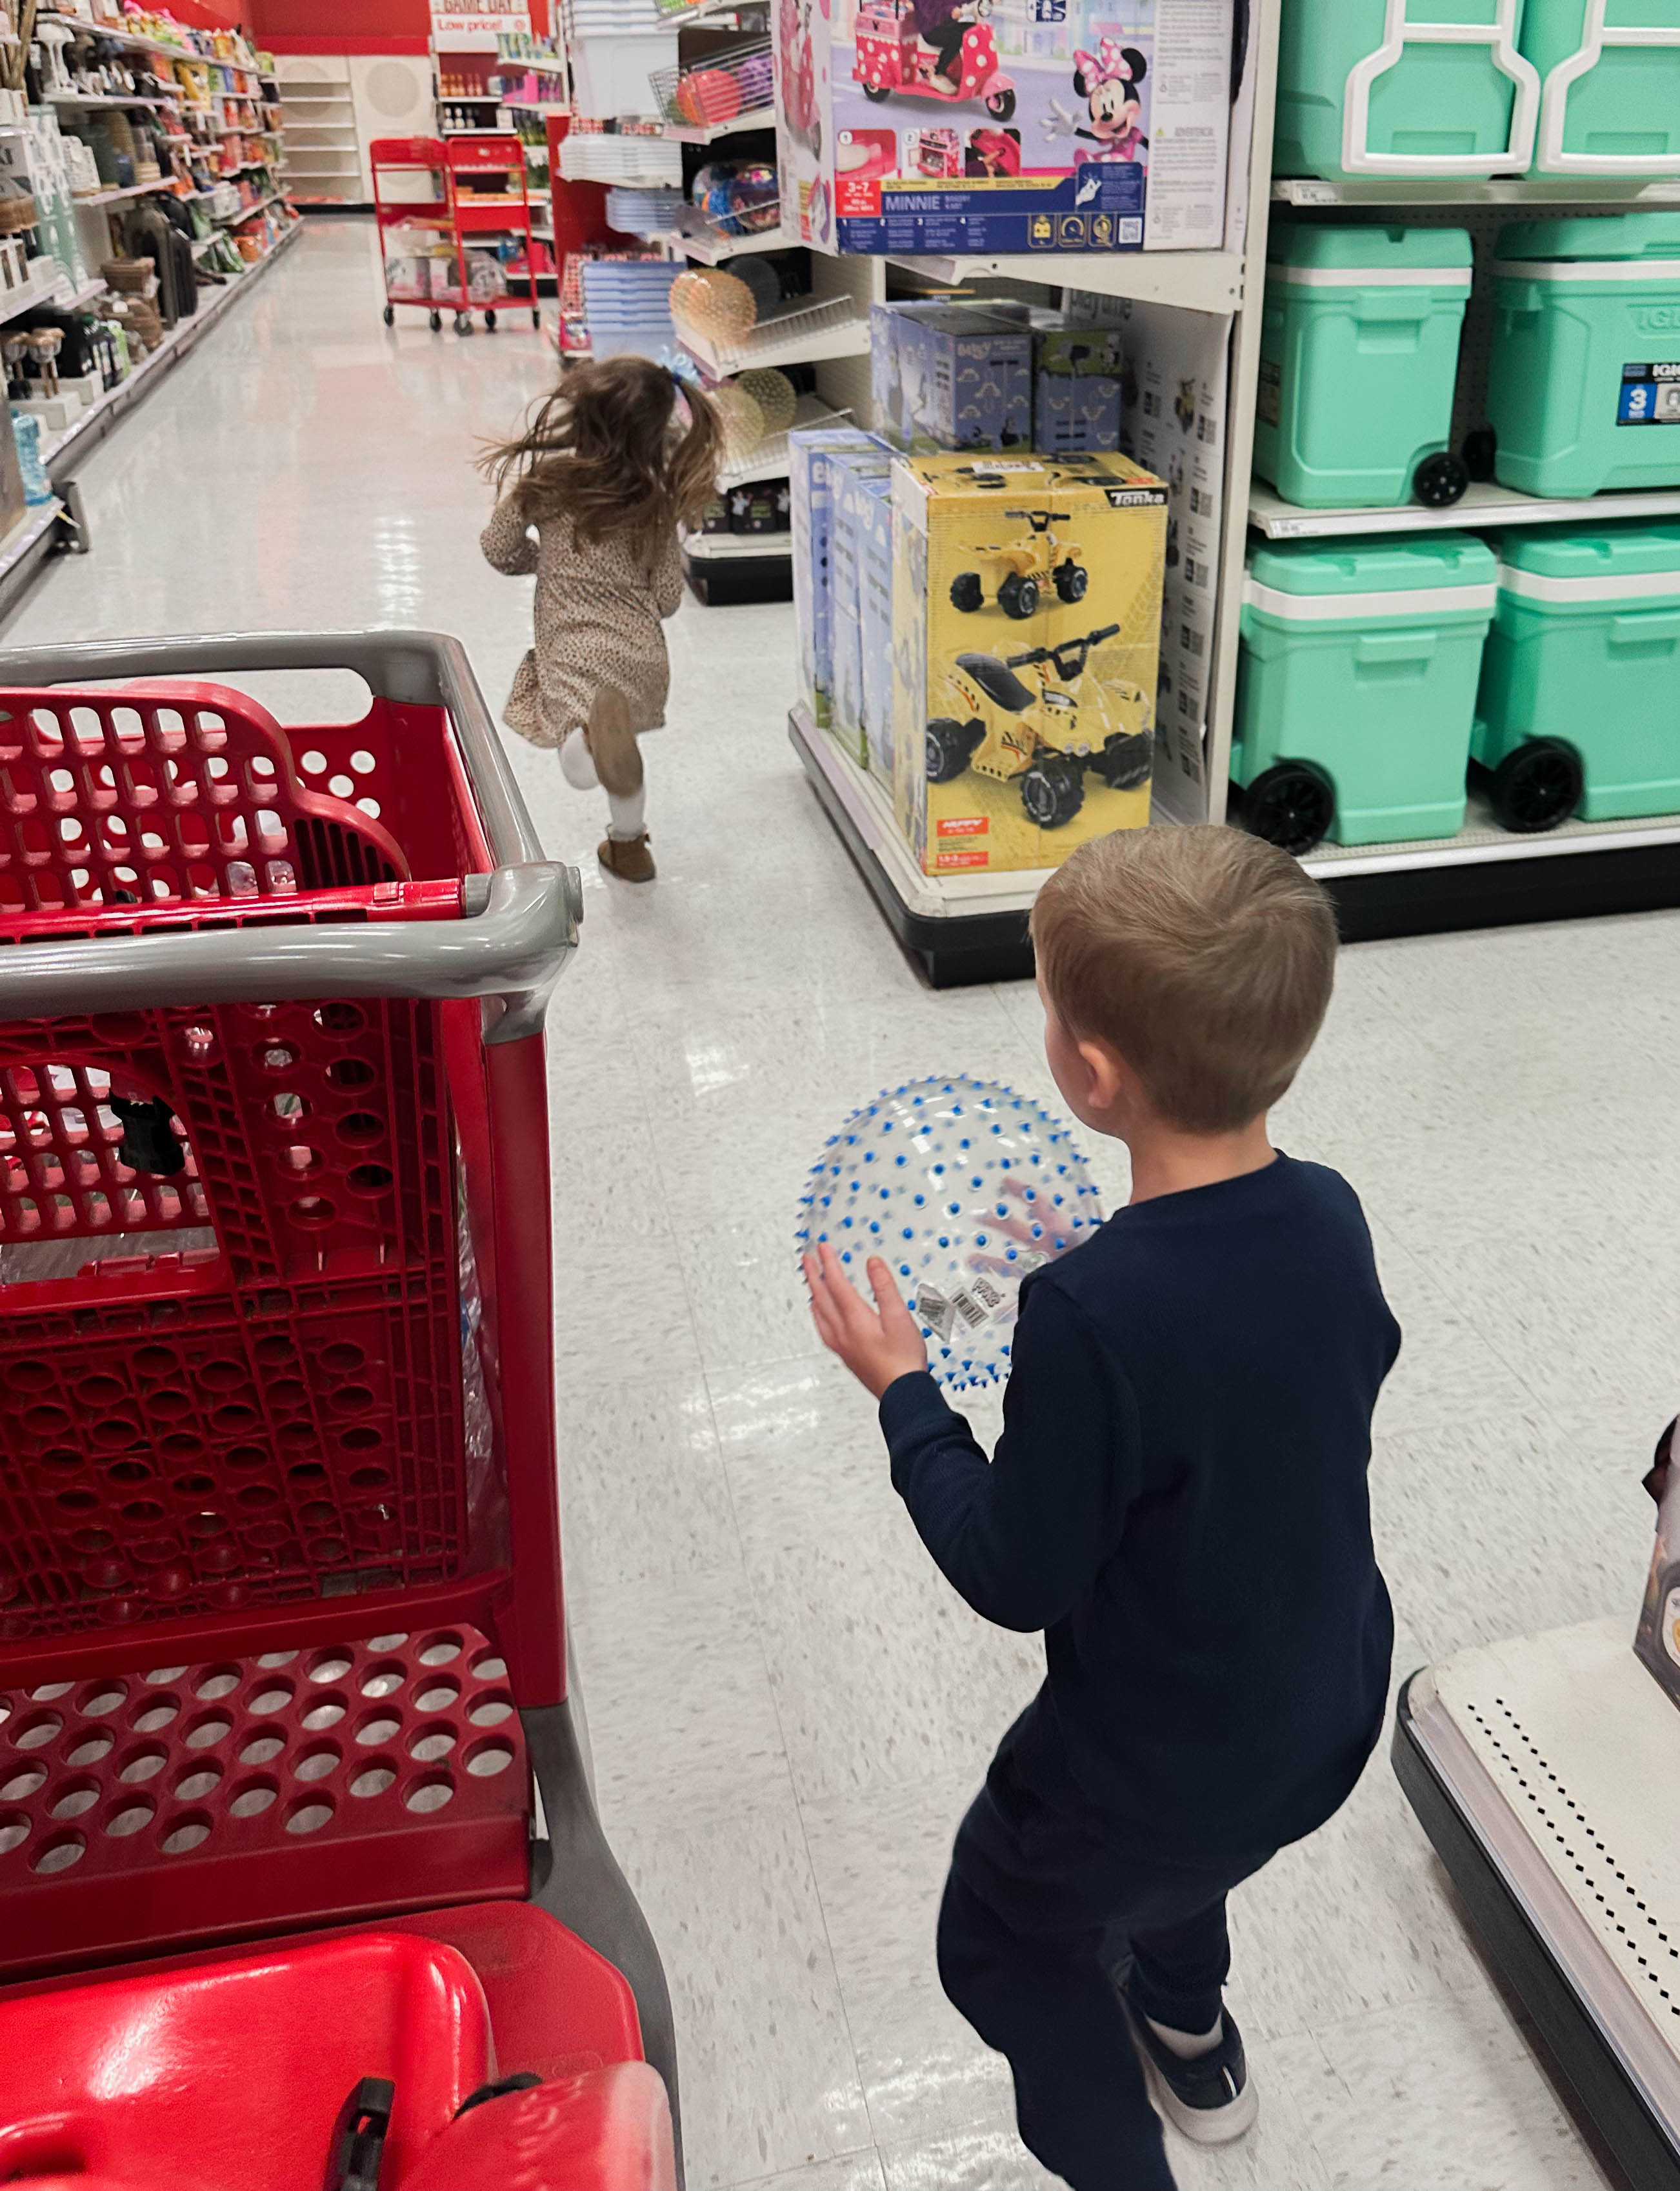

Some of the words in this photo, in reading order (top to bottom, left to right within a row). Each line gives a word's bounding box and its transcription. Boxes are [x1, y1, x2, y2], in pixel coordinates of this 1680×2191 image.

[437, 19, 464, 30] Low
[885, 195, 940, 210] MINNIE
[1628, 388, 1647, 411] 3
[1110, 490, 1164, 506] Tonka
